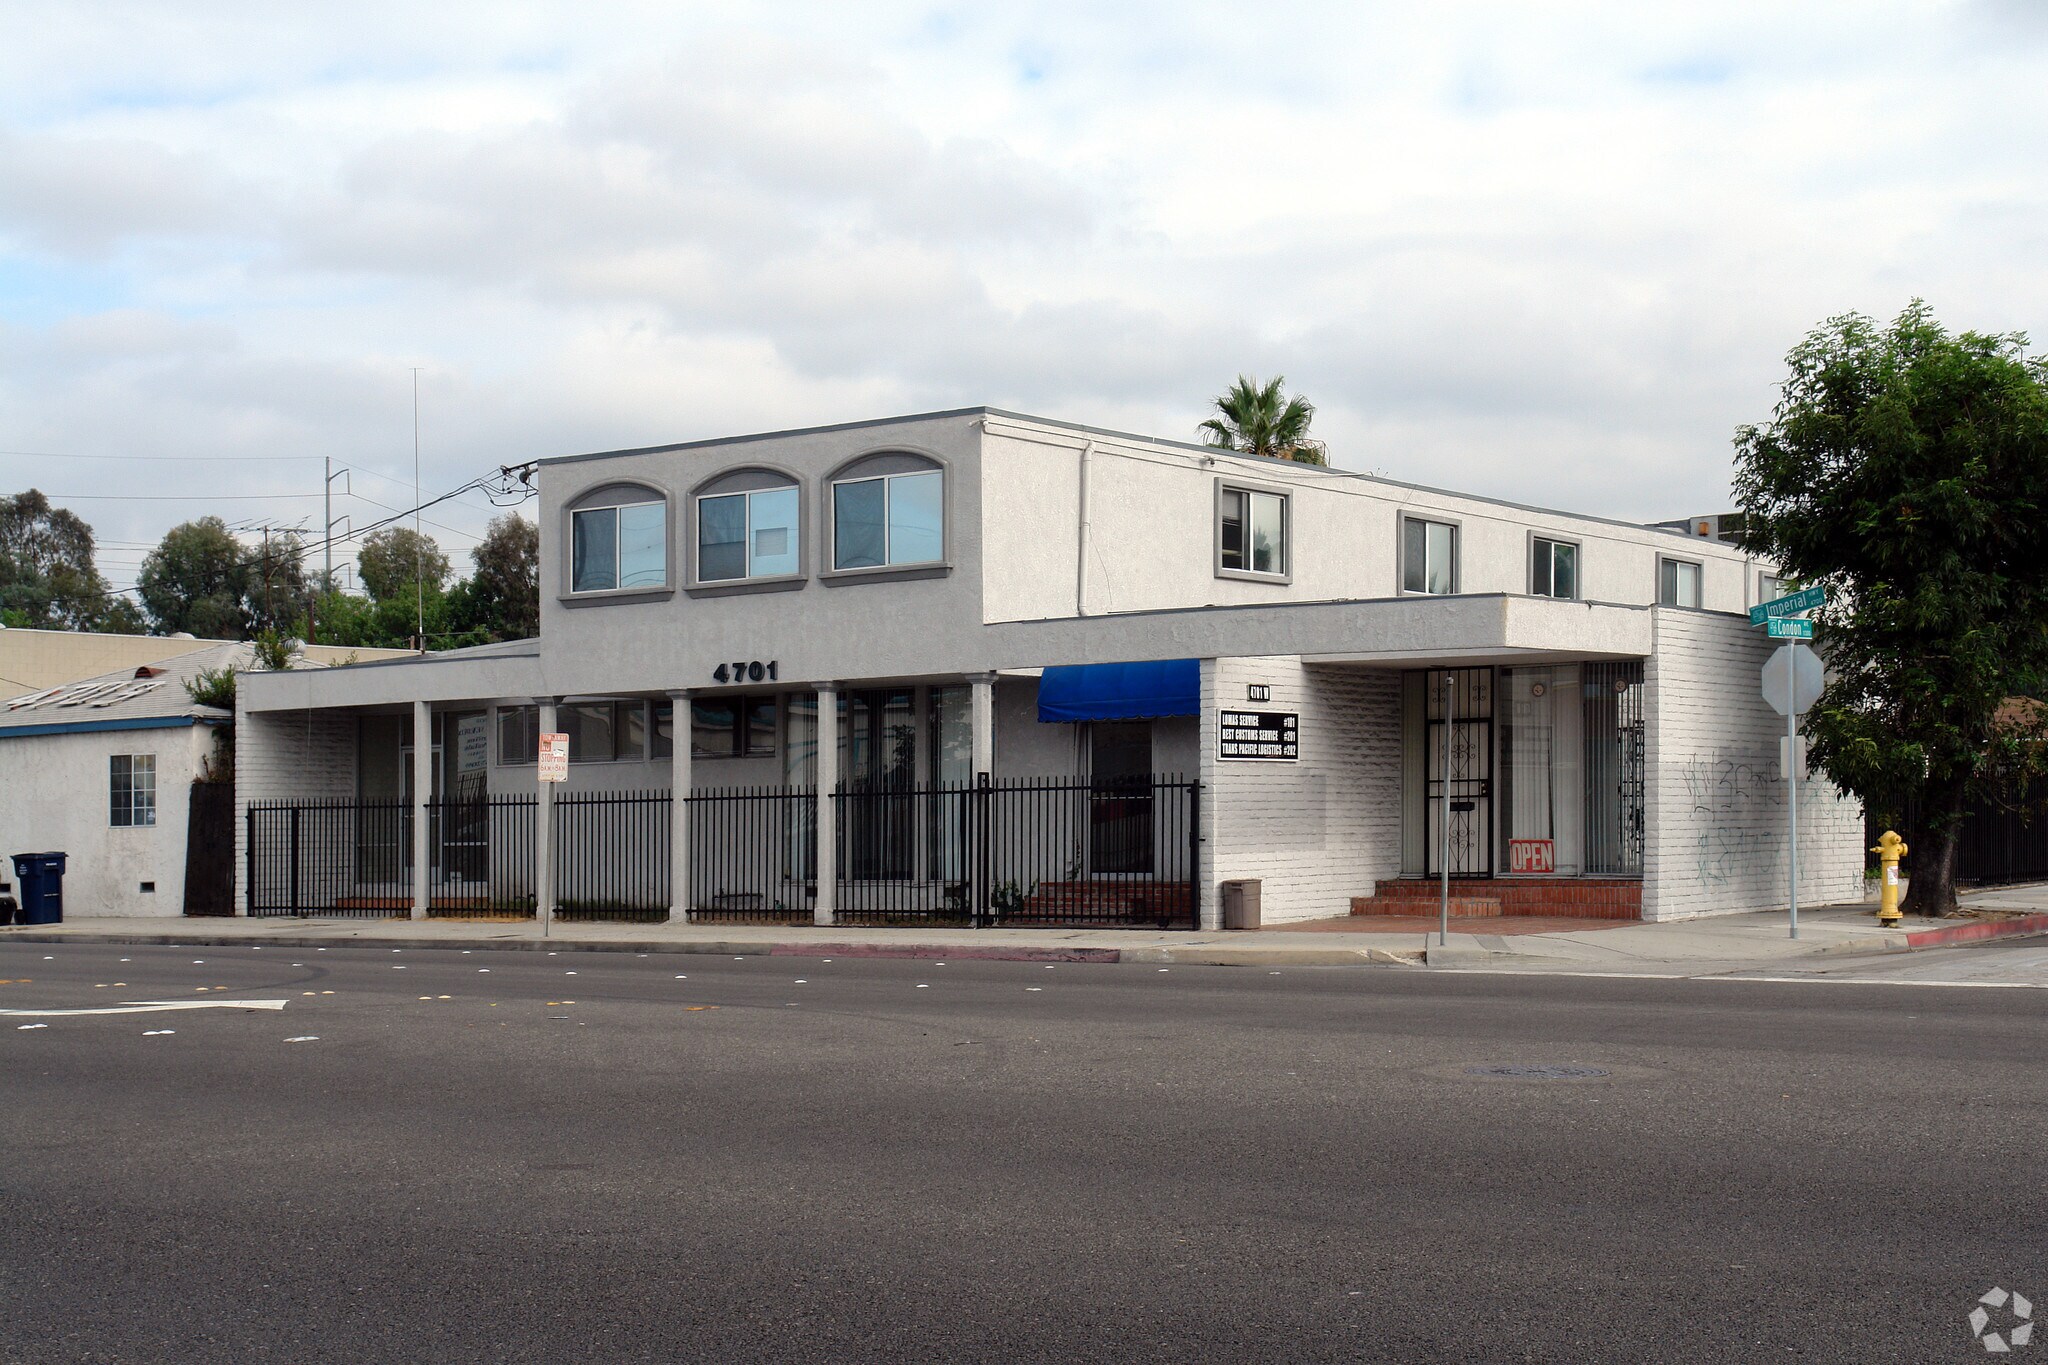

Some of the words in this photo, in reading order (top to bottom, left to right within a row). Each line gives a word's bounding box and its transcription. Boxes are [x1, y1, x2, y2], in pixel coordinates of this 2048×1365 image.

[1765, 593, 1807, 616] Imperial
[1810, 597, 1823, 606] 4700
[1777, 619, 1802, 635] Condon
[713, 660, 779, 684] 4701
[1250, 686, 1263, 699] 4701
[1222, 714, 1238, 726] LOMAS
[1239, 715, 1259, 726] SERVICE
[1283, 717, 1295, 728] #101
[1222, 728, 1234, 740] BEST
[1235, 729, 1258, 741] CUSTOMS
[1259, 730, 1278, 741] SERVICE
[1283, 731, 1296, 742] #201
[1222, 743, 1238, 754] TRANS
[1238, 743, 1258, 755] PACIFIC
[1258, 744, 1282, 755] LOGISTICS
[1283, 745, 1296, 756] #202
[541, 754, 566, 763] STOPPING
[1511, 842, 1553, 870] OPEN
